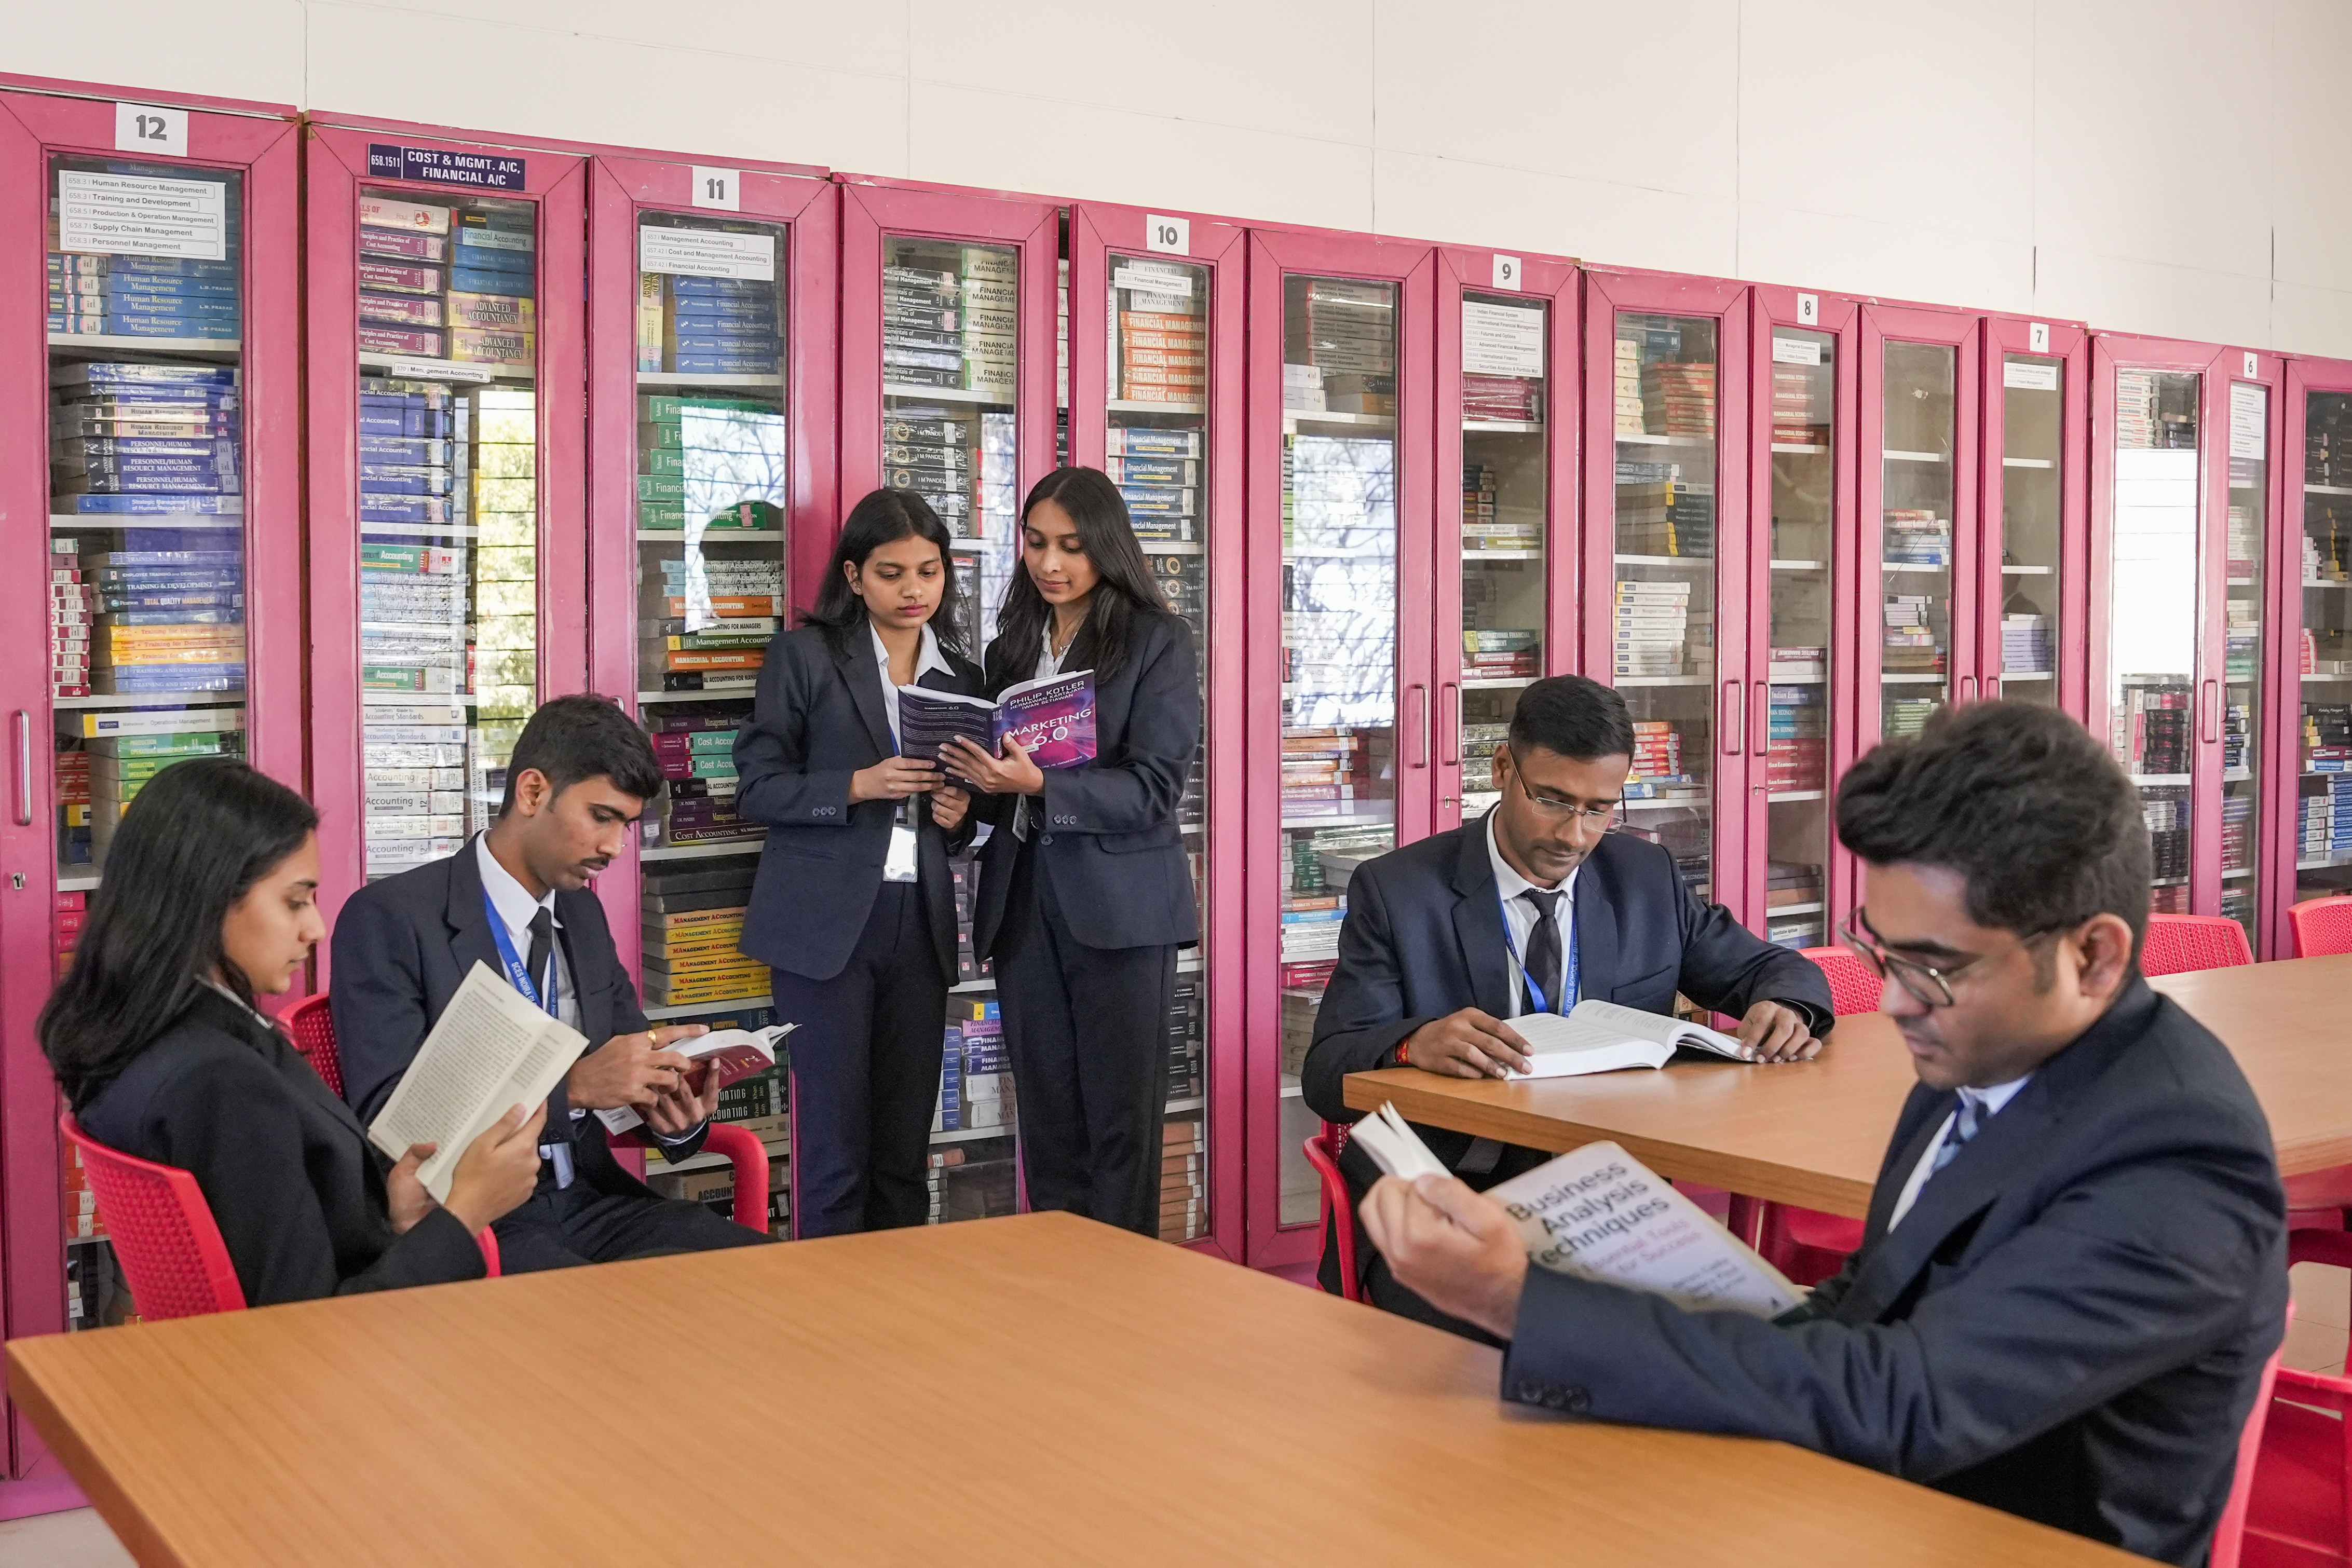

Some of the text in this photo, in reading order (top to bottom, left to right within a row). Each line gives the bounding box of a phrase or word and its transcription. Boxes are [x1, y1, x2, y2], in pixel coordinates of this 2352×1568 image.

[135, 114, 167, 141] 12
[371, 155, 400, 168] 658.1511
[407, 152, 520, 174] COST & MGMT. A/C,
[423, 167, 506, 185] FINANCIAL A/C
[121, 182, 157, 190] Resource
[159, 185, 207, 194] Management
[706, 179, 724, 199] 11
[92, 194, 124, 203] Training
[142, 198, 191, 207] Development
[93, 209, 129, 217] Production
[93, 223, 118, 231] Supply
[144, 227, 193, 236] Management
[1158, 225, 1177, 245] 10
[464, 229, 526, 246] Financial Accounting
[661, 235, 699, 243] Management
[700, 239, 733, 247] Accounting
[132, 241, 181, 250] Management
[696, 252, 733, 260] Management
[734, 254, 767, 263] Accounting
[697, 265, 729, 273] Accounting
[1502, 263, 1511, 280] 9
[123, 275, 183, 284] Human Resource
[151, 296, 183, 304] Resource
[131, 304, 175, 312] Management
[474, 302, 510, 312] ADVANCED
[1804, 301, 1811, 316] 8
[151, 318, 182, 326] Resource
[467, 311, 518, 324] ACCOUNTANCY
[901, 317, 933, 325] Management
[1129, 318, 1164, 329] FINANCIAL
[130, 324, 175, 333] Management
[480, 337, 515, 348] ADVANCED
[900, 336, 932, 345] Management
[1132, 336, 1166, 348] FINANCIAL
[2036, 330, 2042, 343] 7
[472, 347, 523, 359] ACCOUNTANCY
[1132, 354, 1167, 364] FINANCIAL
[410, 367, 448, 375] Management
[450, 370, 483, 379] Accounting
[2248, 361, 2253, 373] 6
[1129, 435, 1181, 446] Financial Management
[1126, 463, 1178, 474] Financial Management
[1145, 494, 1175, 503] Management
[1145, 523, 1176, 533] Management
[380, 550, 413, 562] Accounting
[376, 671, 408, 680] Accounting
[1009, 680, 1084, 706] PHILIP KOTLER
[1010, 686, 1085, 710] HERMAWAN KARTAJAYA
[1008, 708, 1091, 737] MARKETING
[1031, 727, 1068, 746] 6.0
[367, 773, 414, 783] Accounting
[365, 797, 413, 806] Accounting
[366, 821, 413, 829] Accounting
[675, 829, 738, 840] COST ACCOUNTING
[365, 844, 414, 854] Accounting
[674, 916, 710, 924] MANAGEMENT
[511, 961, 533, 998] SCES INDIRA
[1568, 961, 1578, 986] SCHOOL
[1565, 988, 1575, 1014] GLOBAL
[1505, 1161, 1628, 1223] Business
[1539, 1177, 1649, 1236] Analysis
